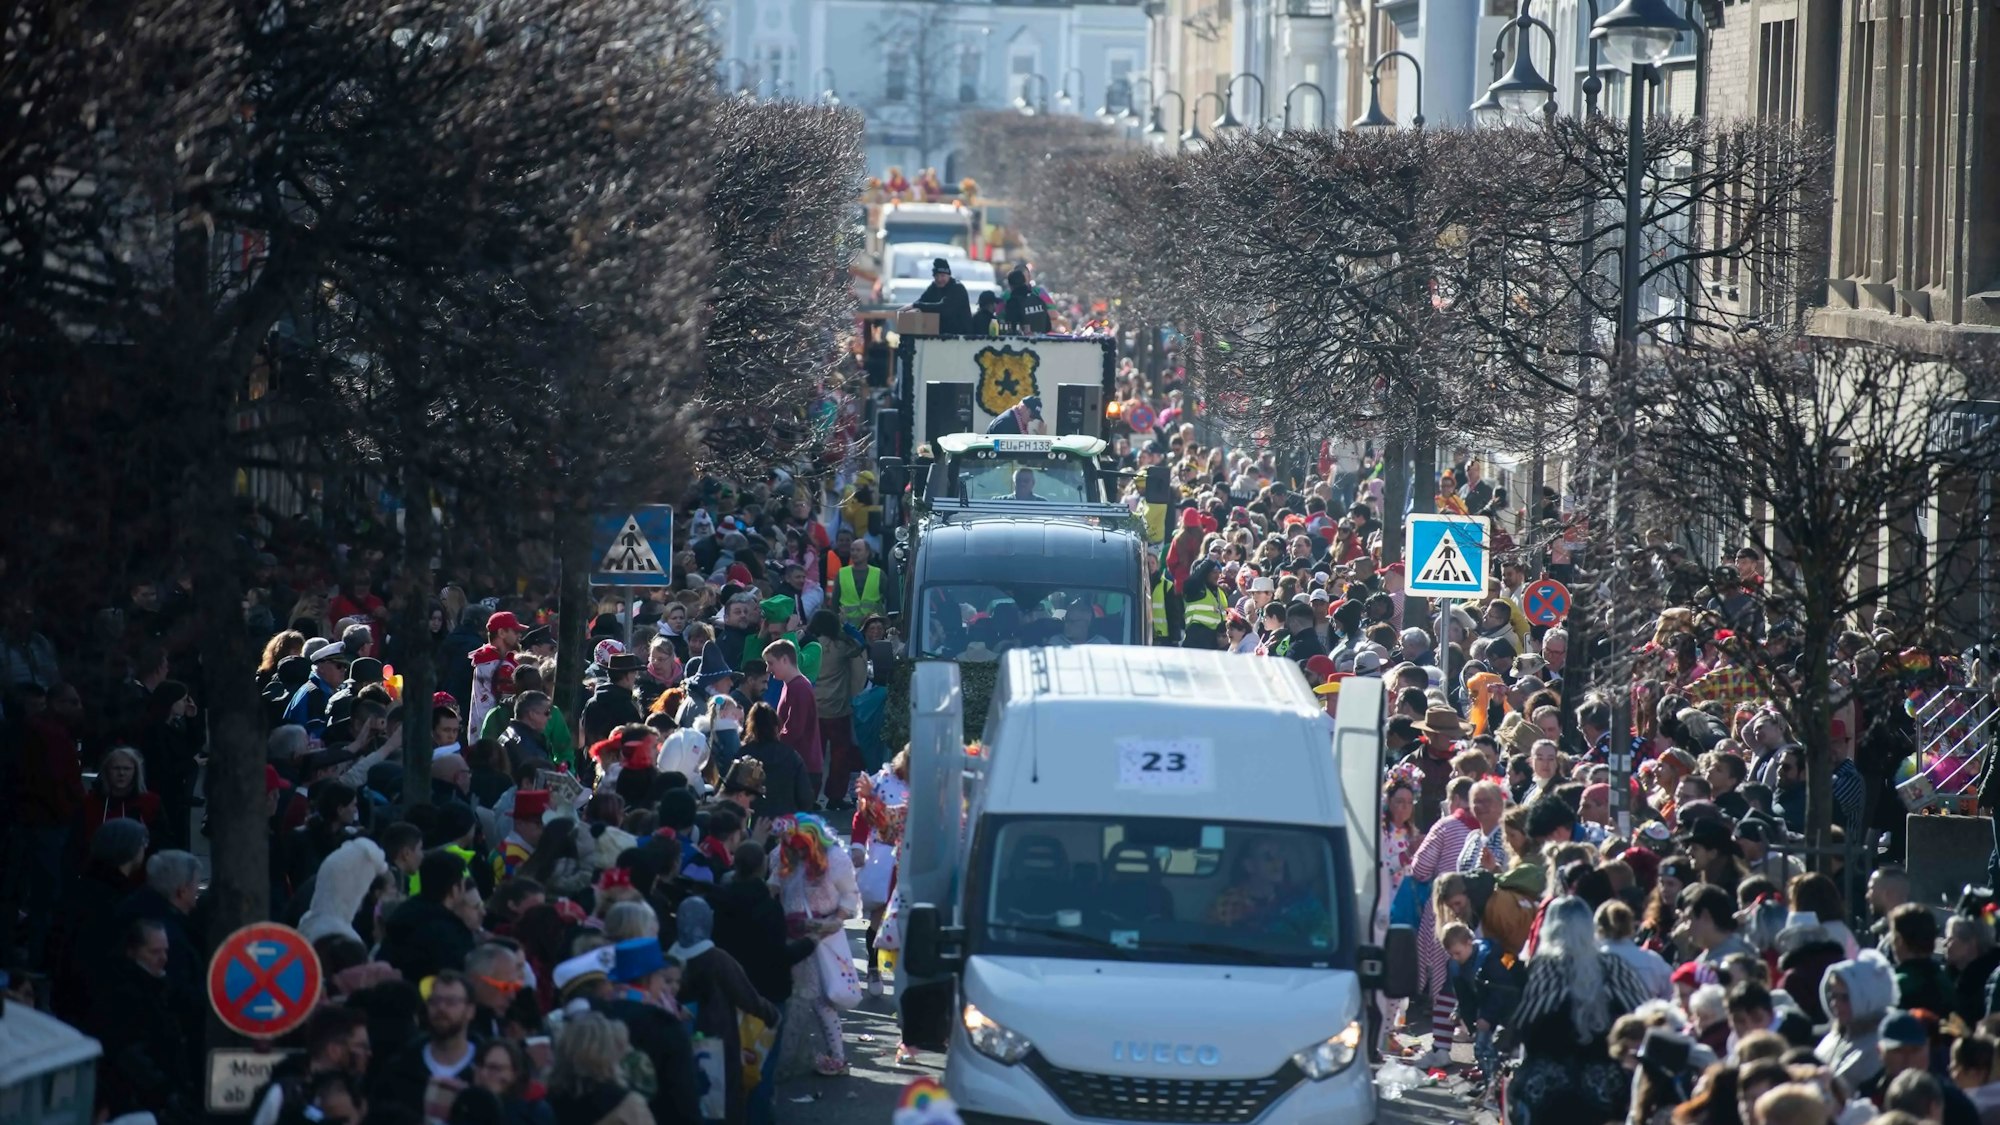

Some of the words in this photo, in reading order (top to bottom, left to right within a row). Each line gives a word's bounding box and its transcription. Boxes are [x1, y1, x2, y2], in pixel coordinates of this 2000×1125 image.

[1033, 441, 1050, 451] 133
[1141, 752, 1187, 772] 23
[1113, 1040, 1220, 1068] IVECO
